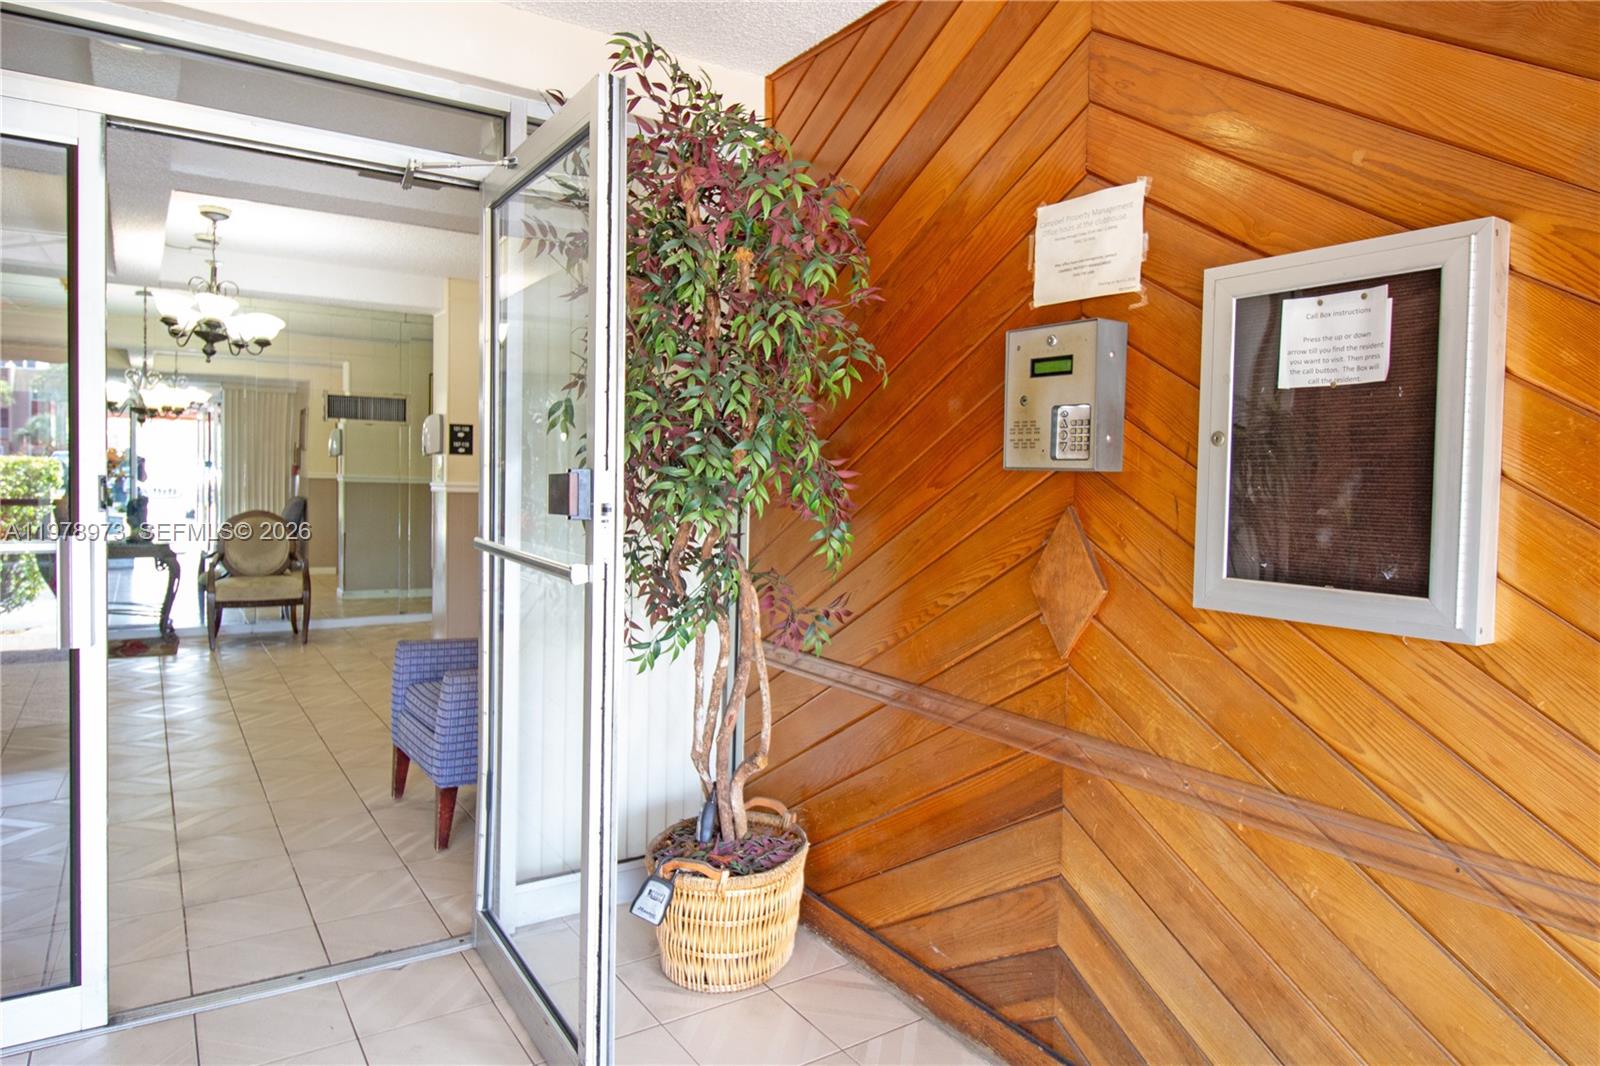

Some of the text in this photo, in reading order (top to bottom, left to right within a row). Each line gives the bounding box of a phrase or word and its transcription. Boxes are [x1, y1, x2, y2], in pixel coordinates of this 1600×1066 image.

[1092, 202, 1134, 216] Management
[1353, 331, 1371, 339] down
[1359, 342, 1384, 350] resident
[1364, 353, 1380, 361] press
